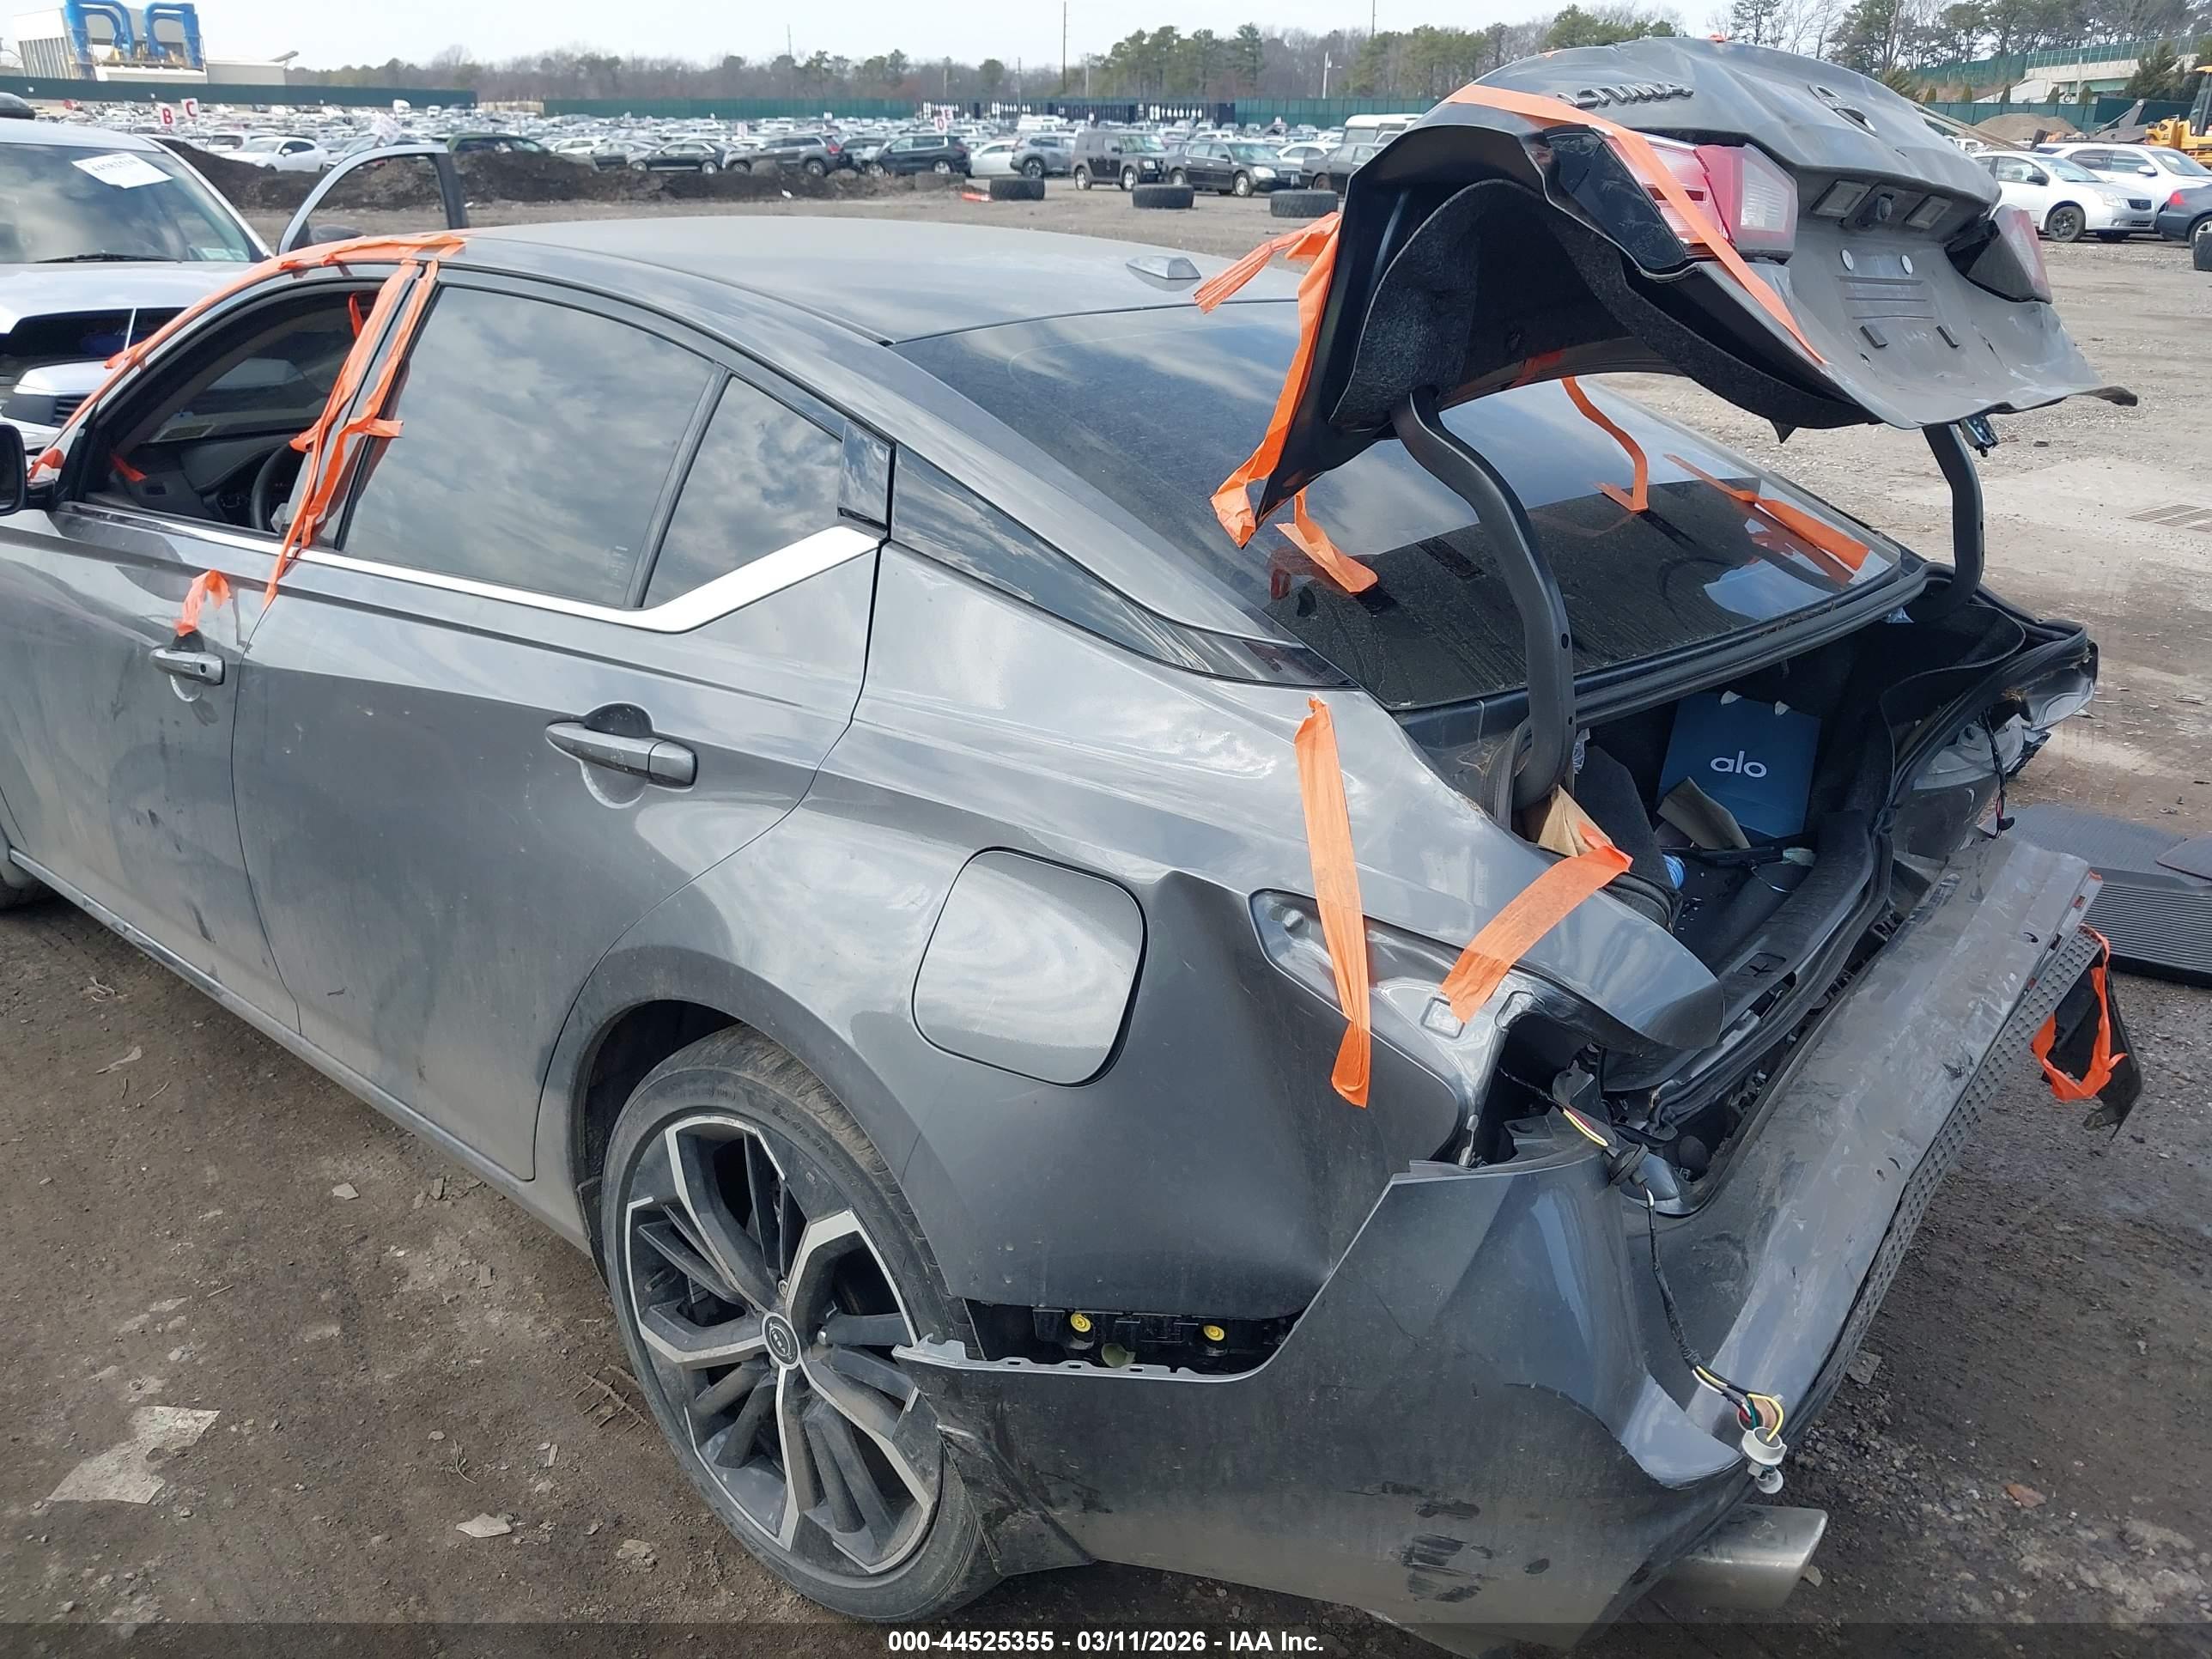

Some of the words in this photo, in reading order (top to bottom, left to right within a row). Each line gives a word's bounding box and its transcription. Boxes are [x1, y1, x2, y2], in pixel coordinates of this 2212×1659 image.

[1556, 81, 1695, 109] LTIMA
[161, 107, 173, 125] B
[185, 100, 198, 118] C
[1710, 750, 1767, 778] alo
